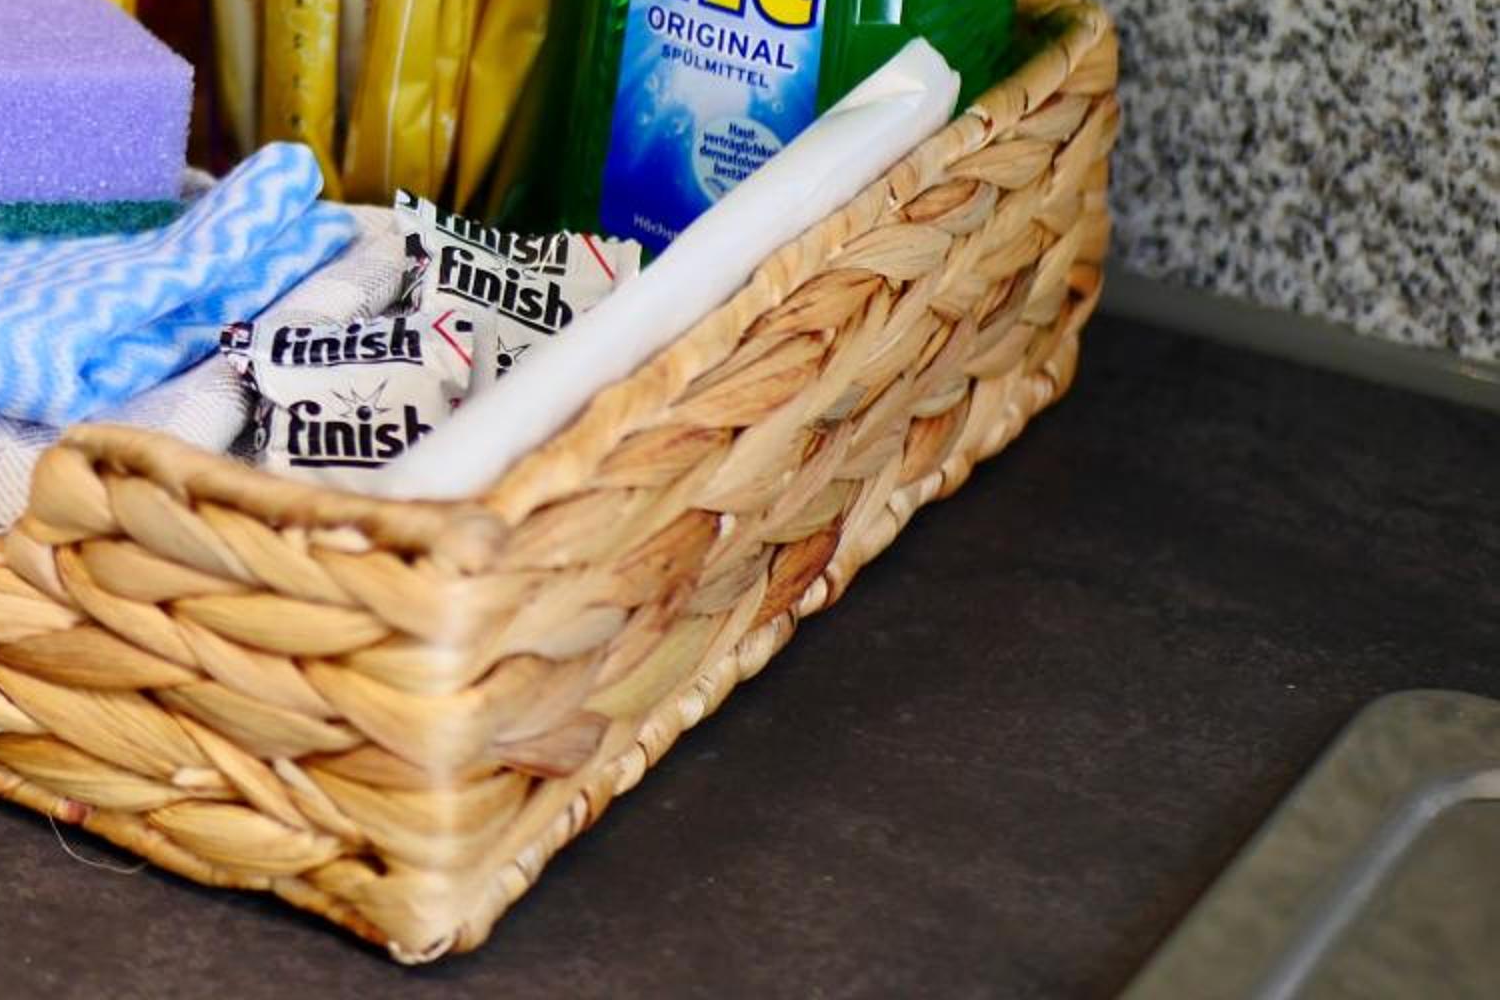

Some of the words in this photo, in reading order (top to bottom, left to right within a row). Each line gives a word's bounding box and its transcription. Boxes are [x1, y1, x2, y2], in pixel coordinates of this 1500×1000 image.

[648, 6, 794, 69] ORIGINAL
[661, 43, 770, 89] SPÜLMITTEL
[439, 246, 573, 329] finish
[271, 317, 422, 365] finish
